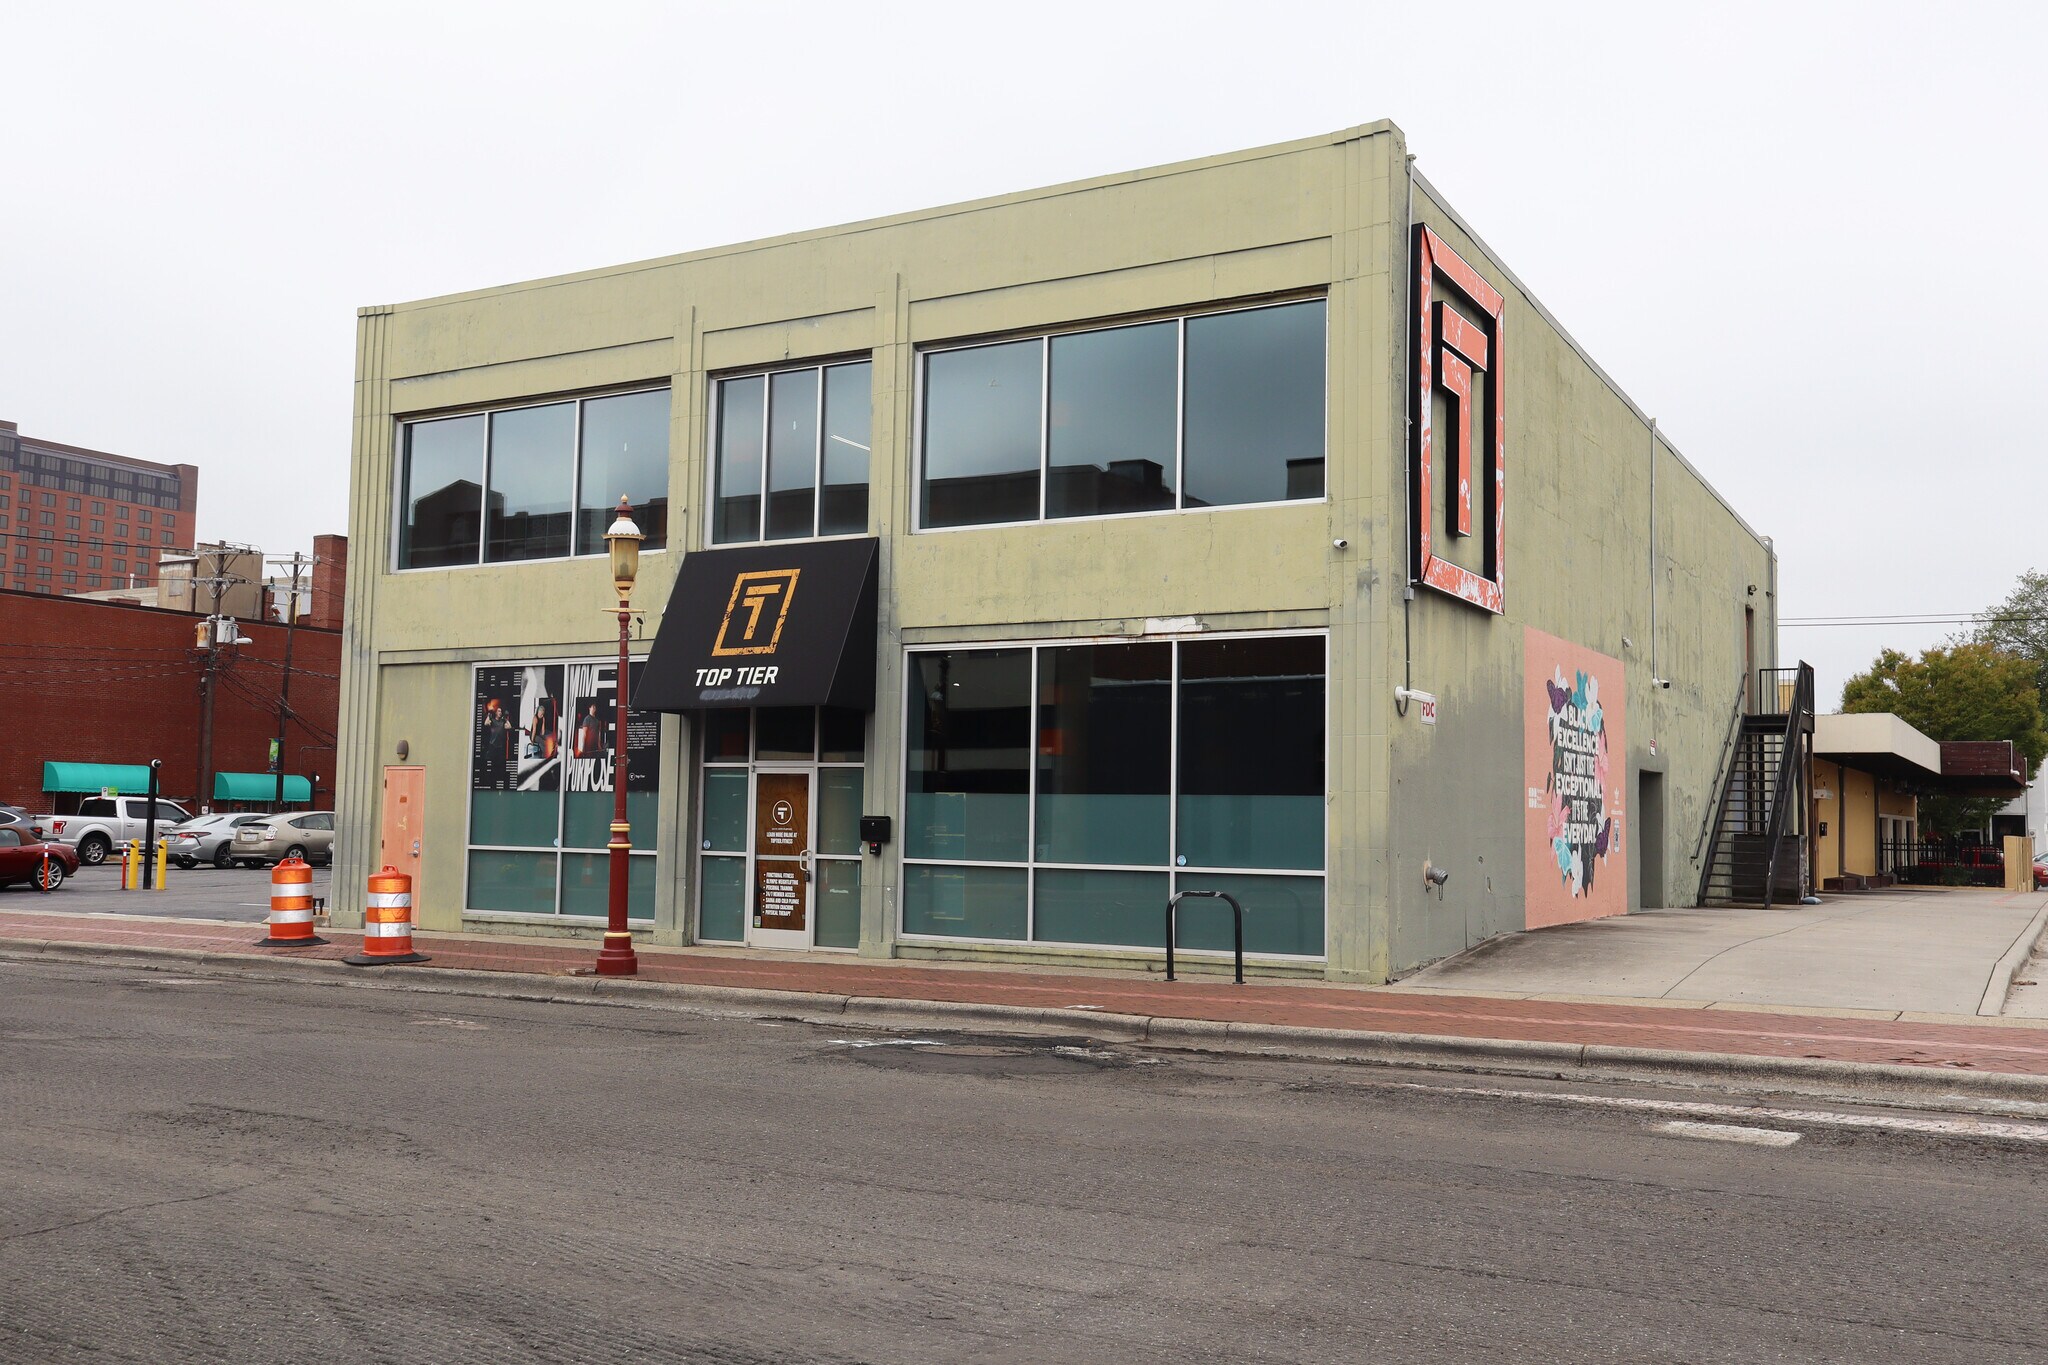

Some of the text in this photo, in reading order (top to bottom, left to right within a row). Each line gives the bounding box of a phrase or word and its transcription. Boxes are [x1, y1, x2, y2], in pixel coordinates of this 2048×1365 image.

[695, 665, 779, 687] TOP TIER
[1422, 702, 1435, 718] FDC
[1557, 726, 1599, 753] EXCELLENCE
[565, 748, 617, 791] PURPOSE
[1563, 751, 1595, 777] ISN'T JUST THE
[1580, 800, 1589, 821] THE
